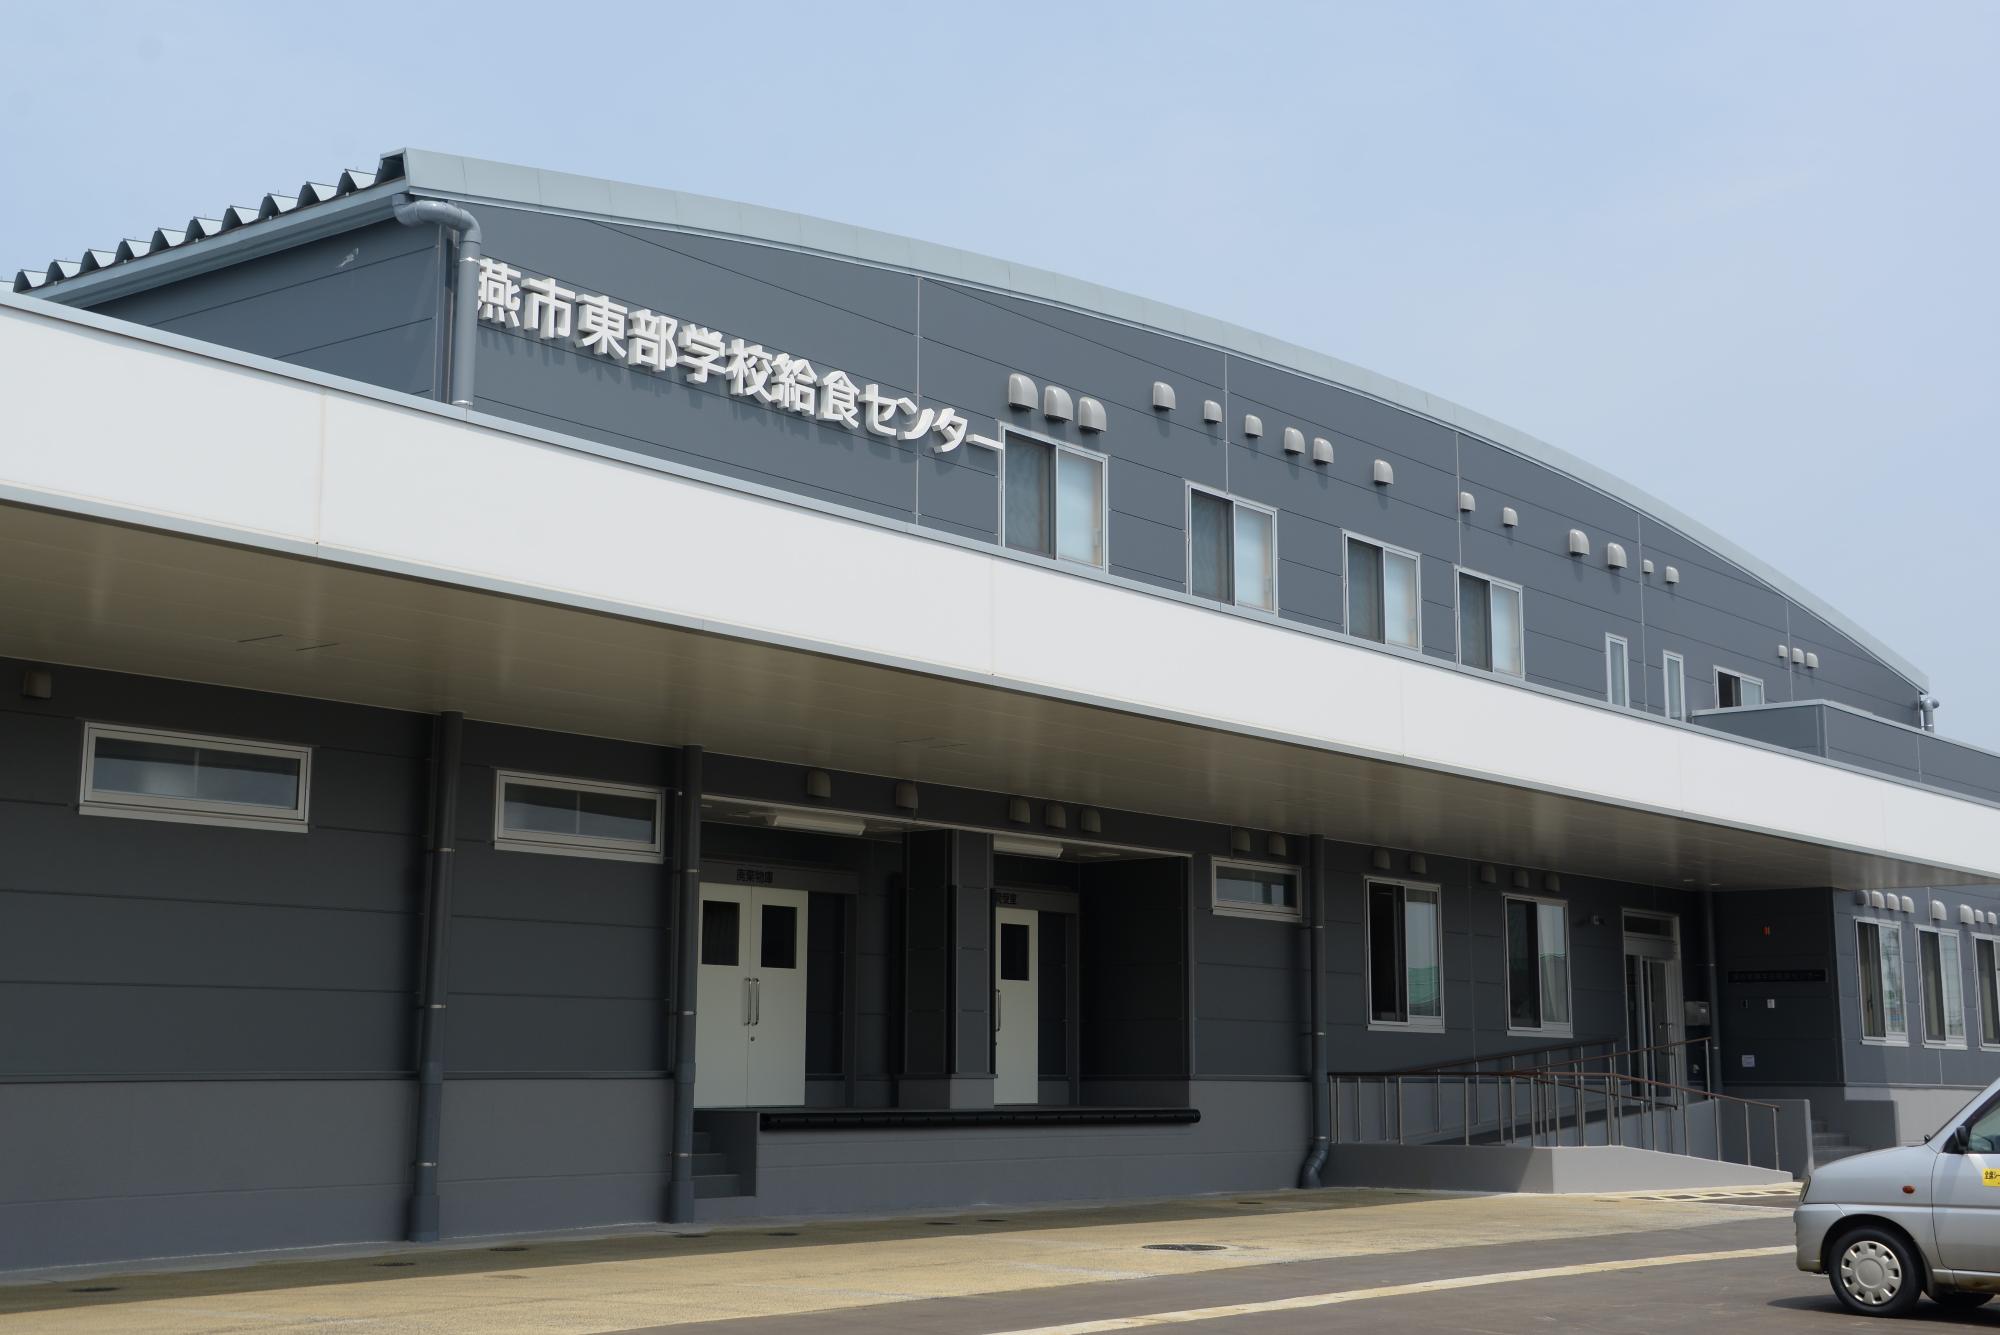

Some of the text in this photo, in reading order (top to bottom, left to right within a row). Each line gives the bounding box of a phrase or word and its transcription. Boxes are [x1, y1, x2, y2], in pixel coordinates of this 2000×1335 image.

[478, 257, 1004, 454] 燕市東部学校給食センター
